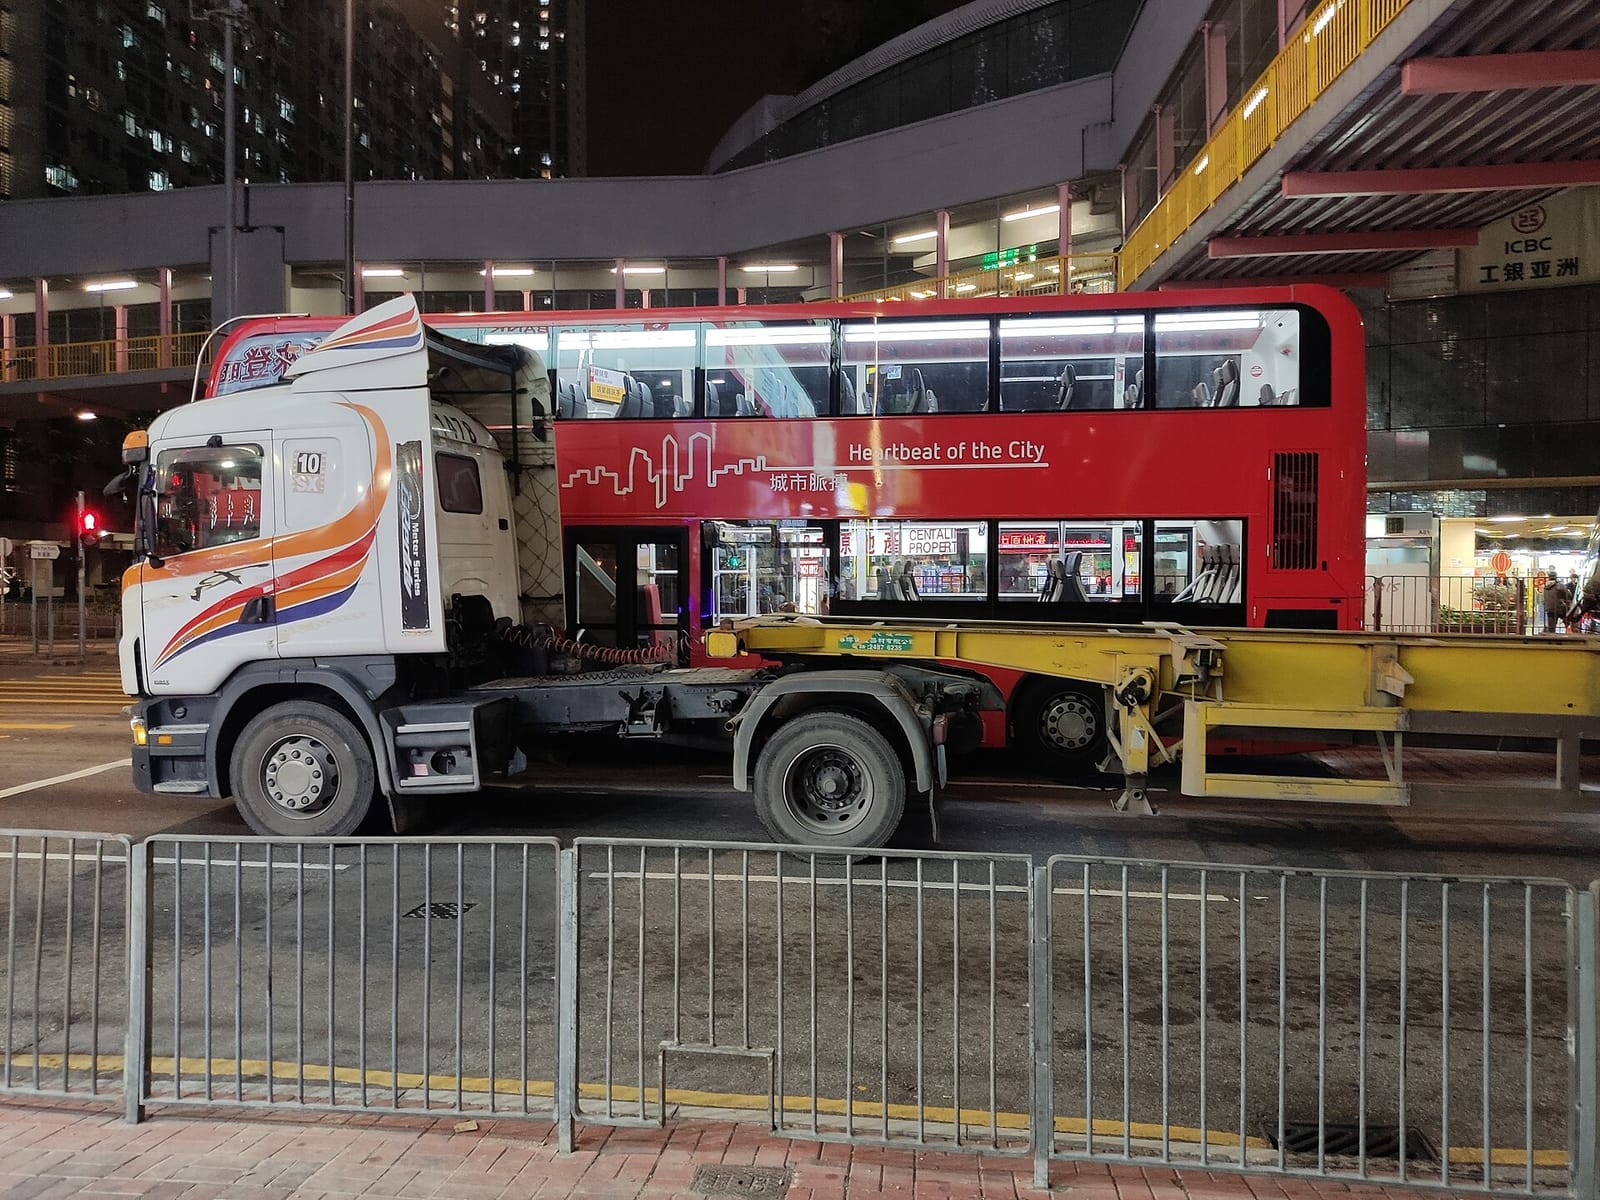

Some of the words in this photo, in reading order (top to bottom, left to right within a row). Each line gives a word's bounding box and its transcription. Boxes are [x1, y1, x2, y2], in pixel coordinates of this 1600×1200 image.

[1505, 237, 1552, 254] ICBC
[1480, 257, 1579, 284] 工银亚洲
[849, 443, 941, 461] Heartbeat
[946, 442, 966, 460] of
[972, 441, 1002, 459] the
[1008, 440, 1046, 463] City
[298, 453, 320, 474] 10
[769, 473, 849, 492] 城市脈搏
[909, 541, 958, 553] PROPERT
[412, 560, 421, 597] Series
